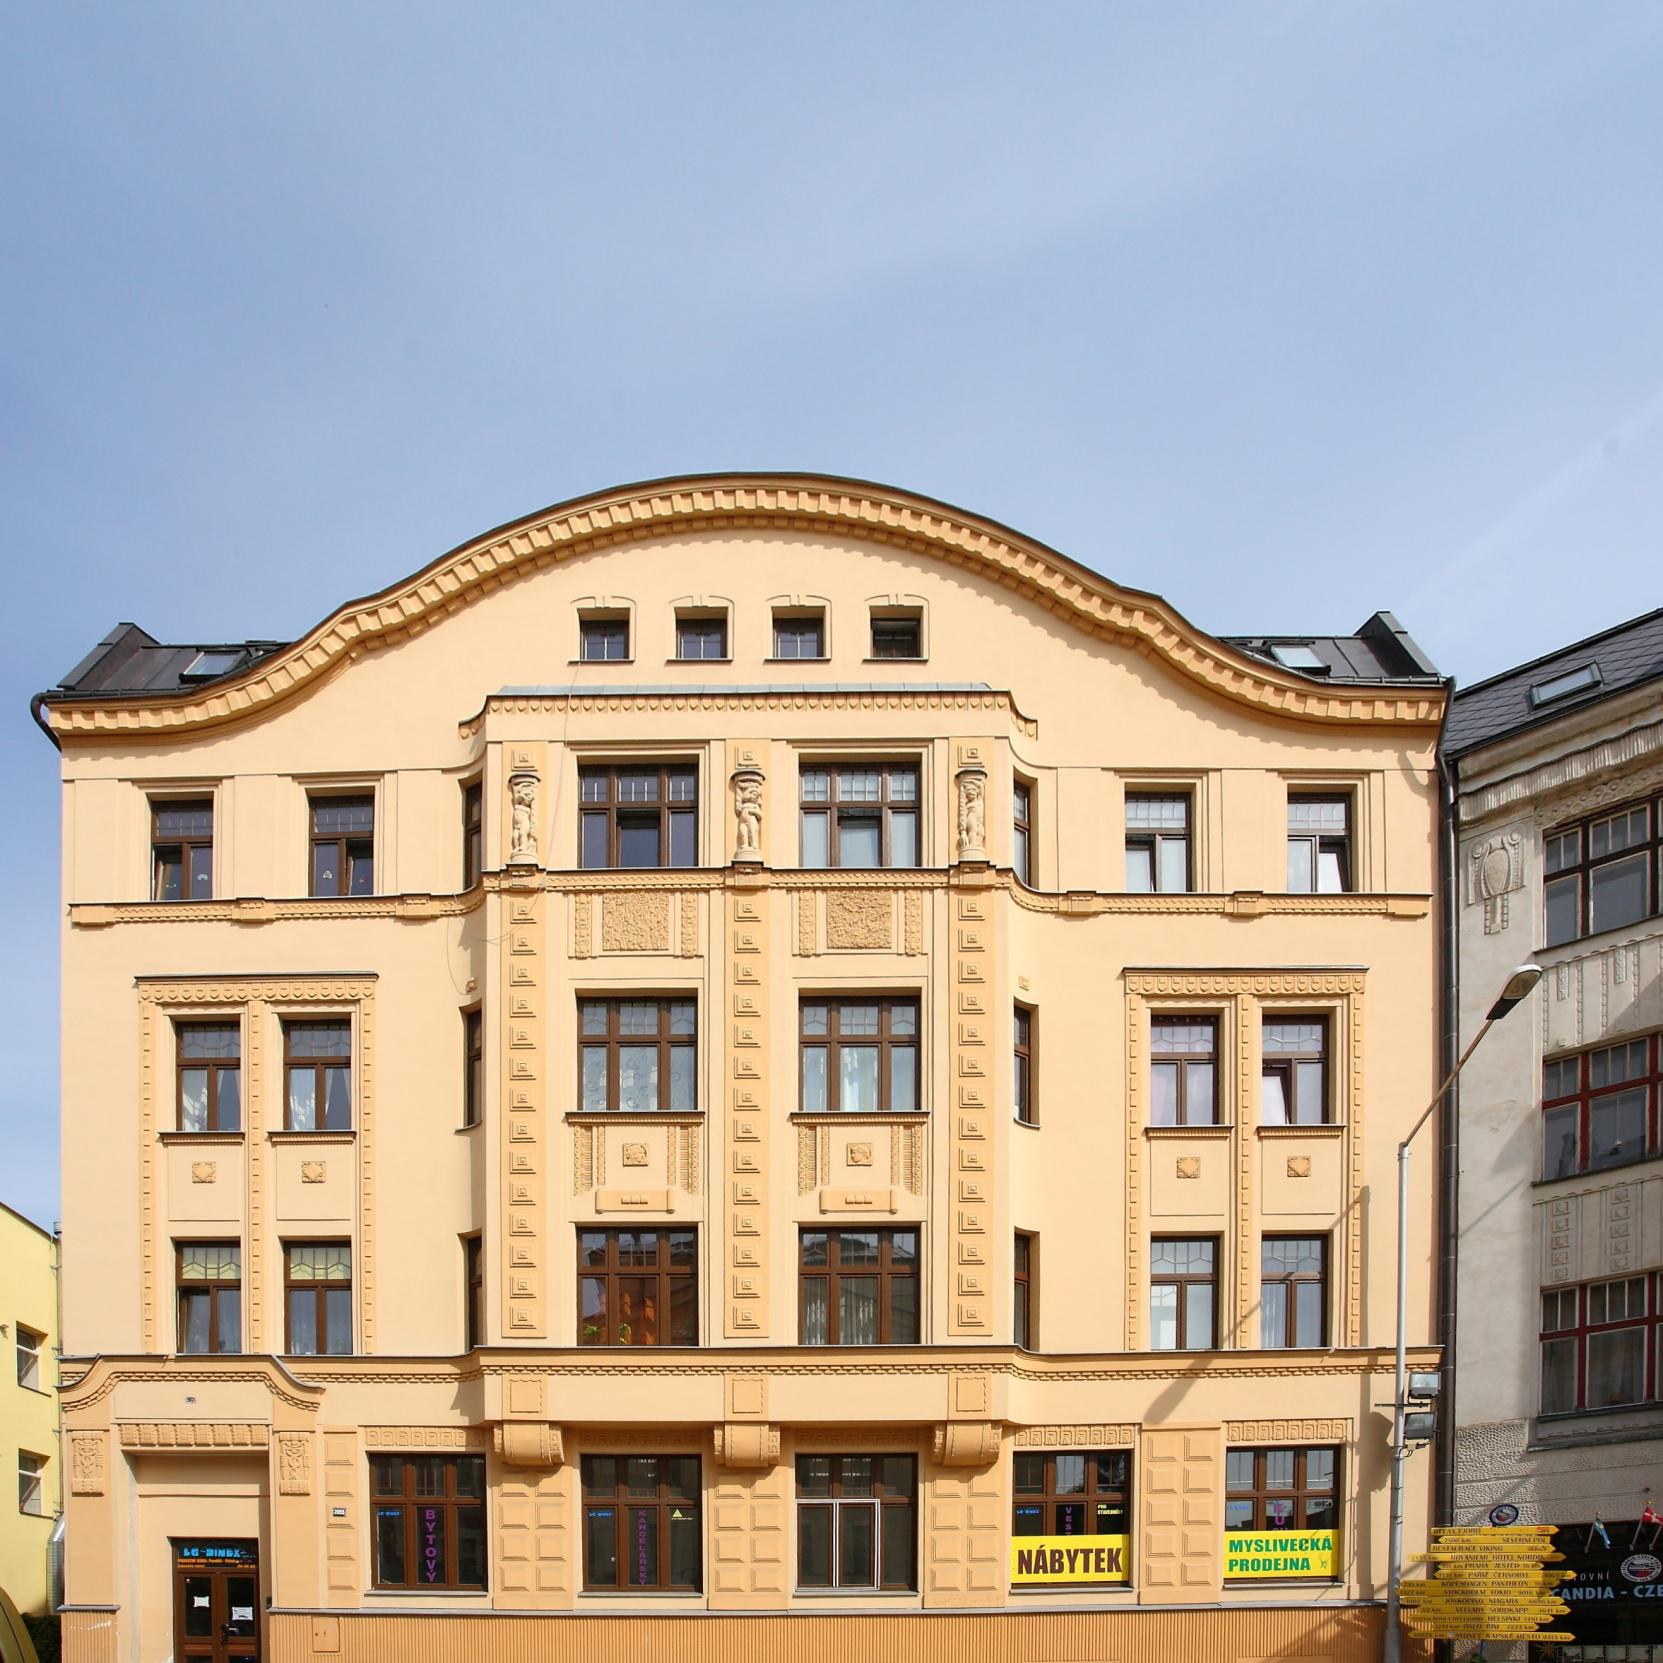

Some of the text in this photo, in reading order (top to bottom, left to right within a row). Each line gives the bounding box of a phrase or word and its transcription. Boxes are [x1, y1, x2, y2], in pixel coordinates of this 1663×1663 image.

[425, 1509, 437, 1582] BYTOVÝ
[1229, 1536, 1333, 1552] MYSLIVECKÁ
[1018, 1544, 1122, 1574] NÁBYTEK
[1228, 1557, 1311, 1572] PRODEJNA
